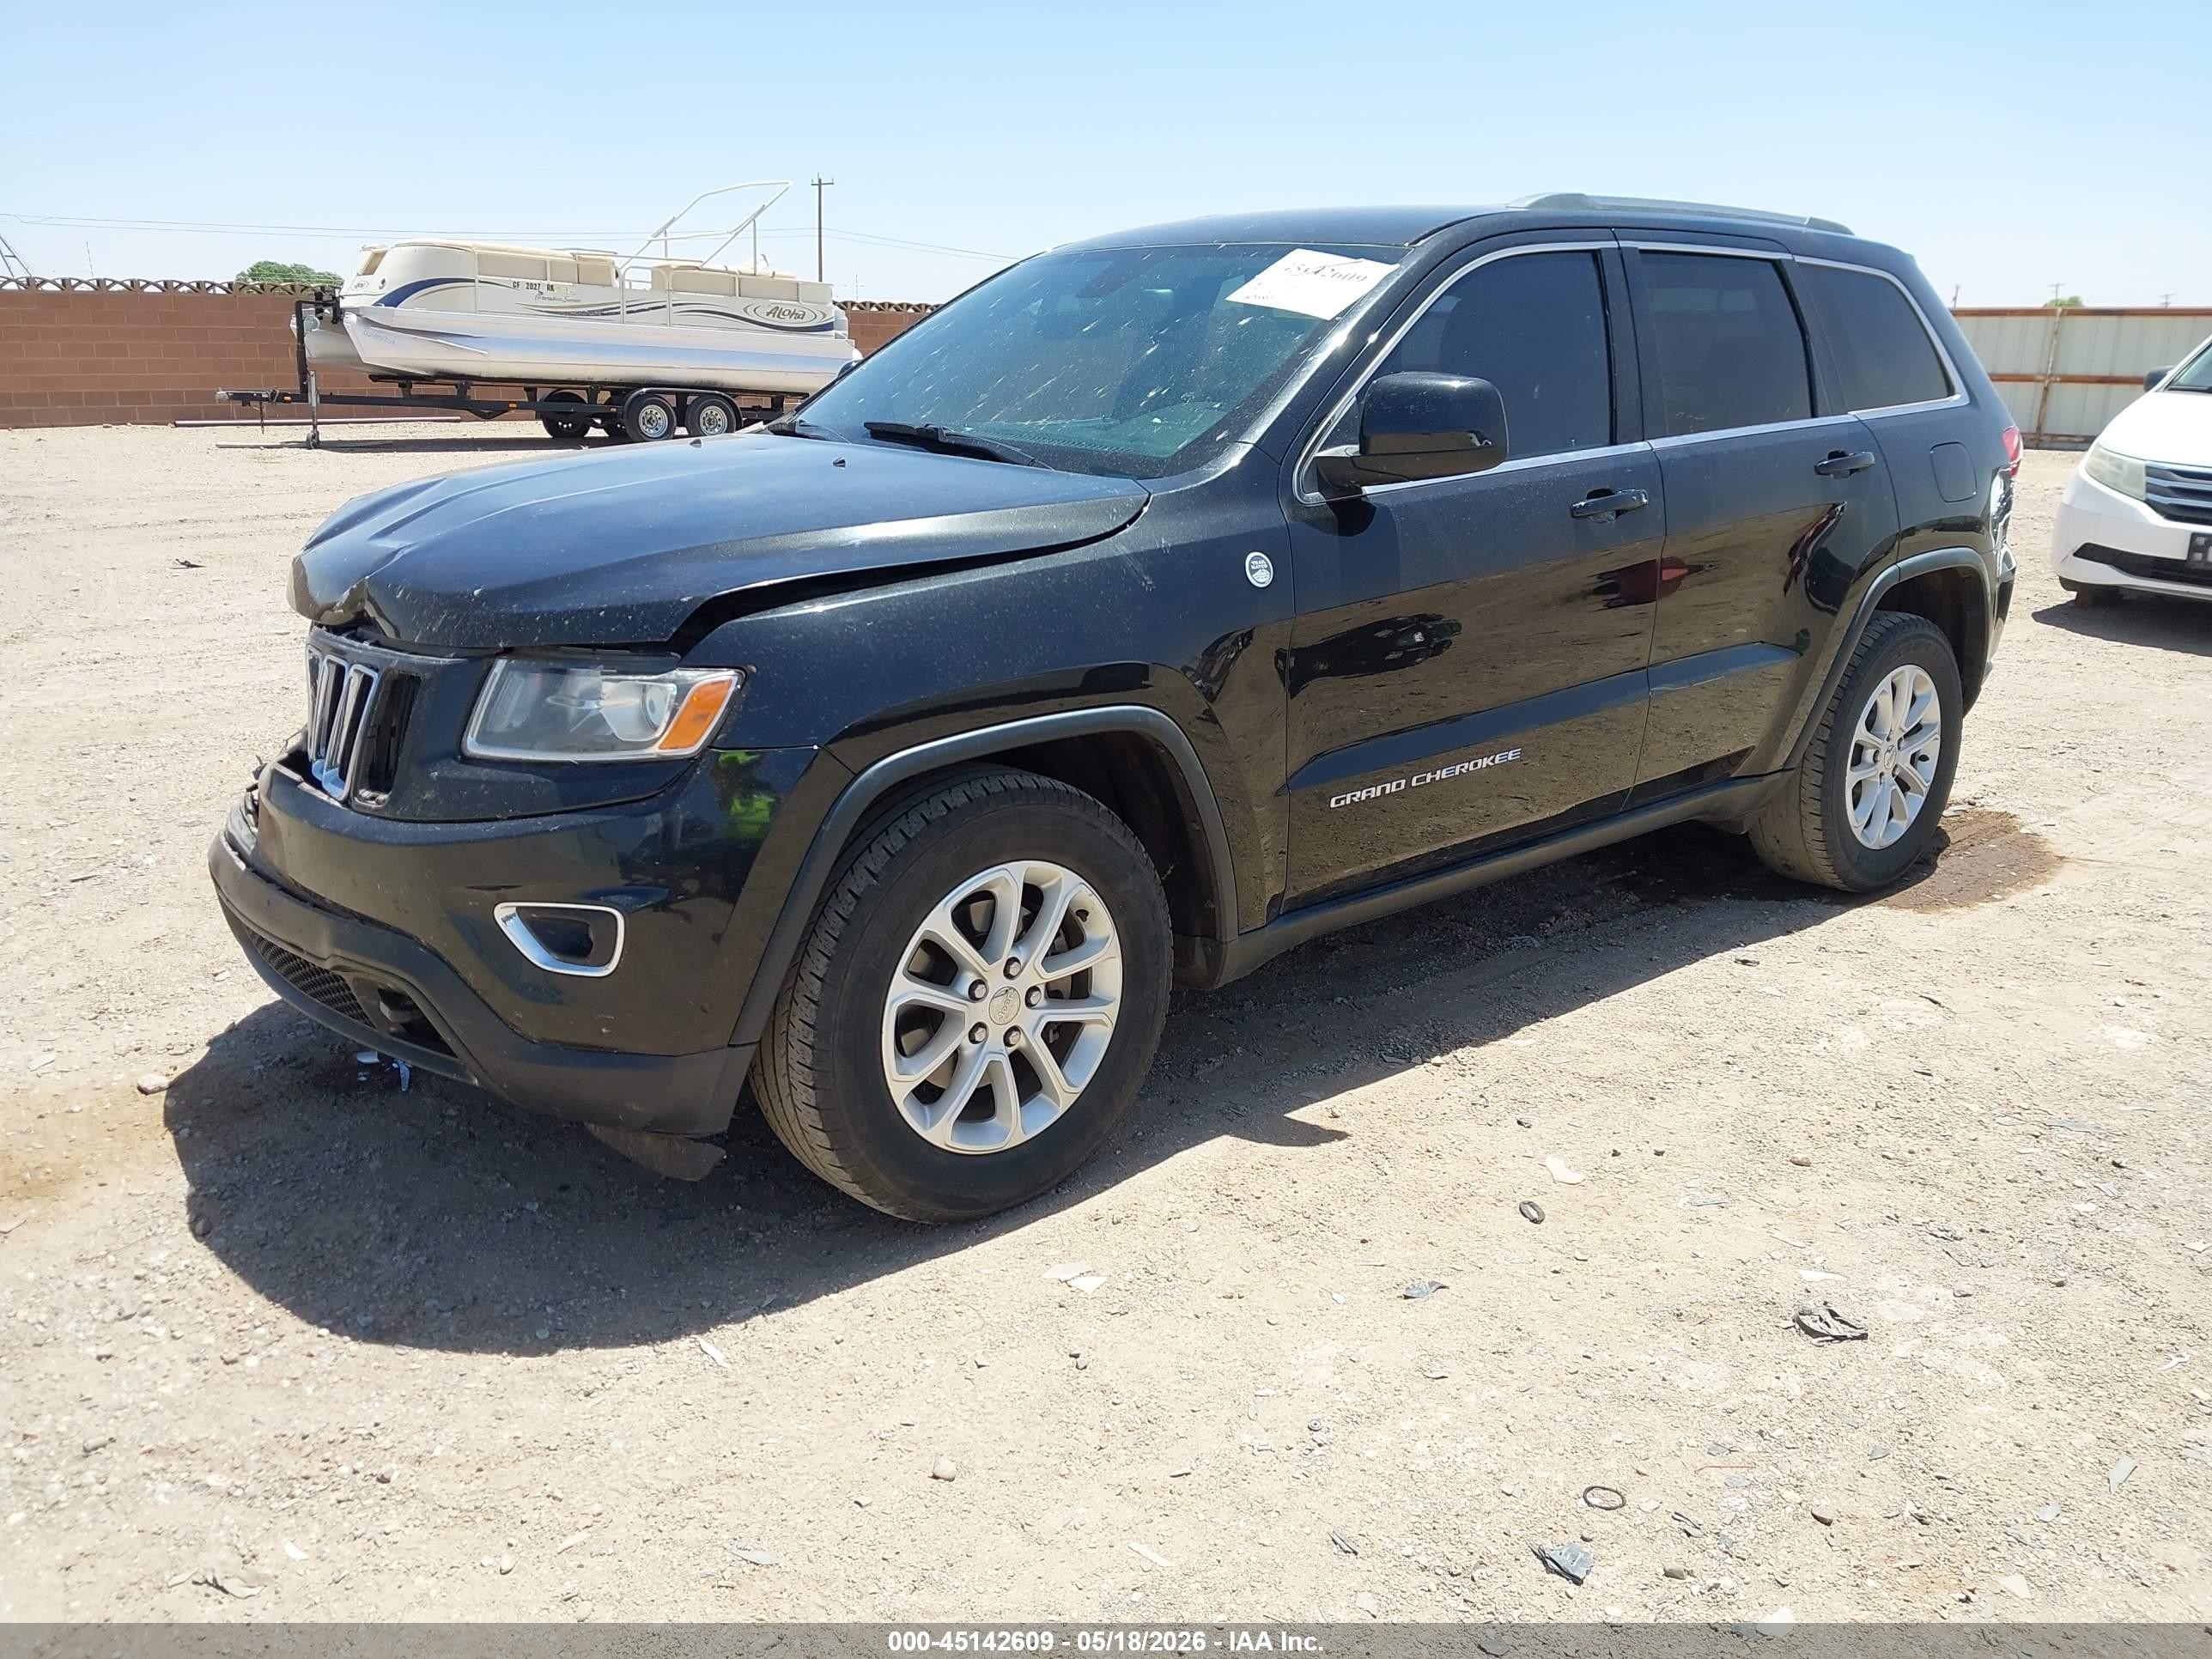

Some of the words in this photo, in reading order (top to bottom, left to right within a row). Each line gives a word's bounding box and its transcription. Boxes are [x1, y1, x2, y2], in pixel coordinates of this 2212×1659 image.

[513, 281, 520, 289] CF
[1329, 779, 1407, 809] GRAND
[1411, 748, 1522, 787] CHEROKEE
